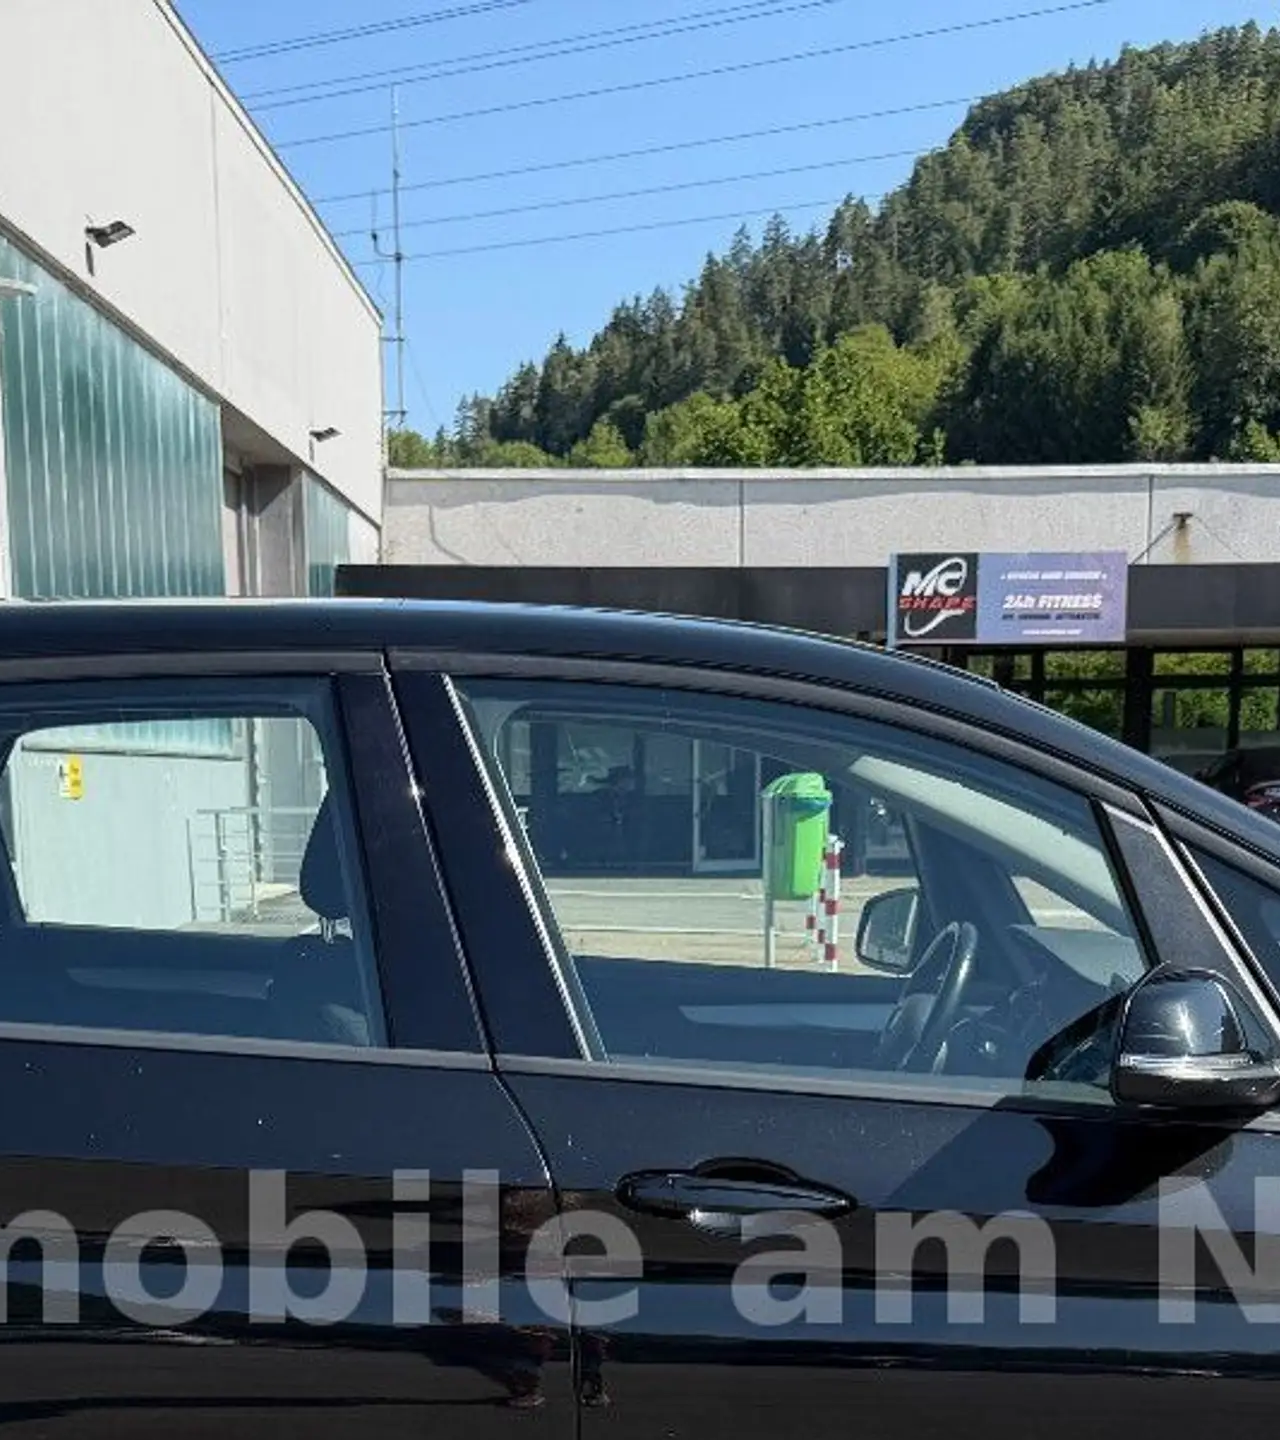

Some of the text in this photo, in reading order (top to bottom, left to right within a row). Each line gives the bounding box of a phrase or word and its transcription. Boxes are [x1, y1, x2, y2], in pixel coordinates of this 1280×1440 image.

[901, 568, 965, 596] MC
[899, 595, 976, 610] SHAPE
[1038, 593, 1103, 609] FITNESS
